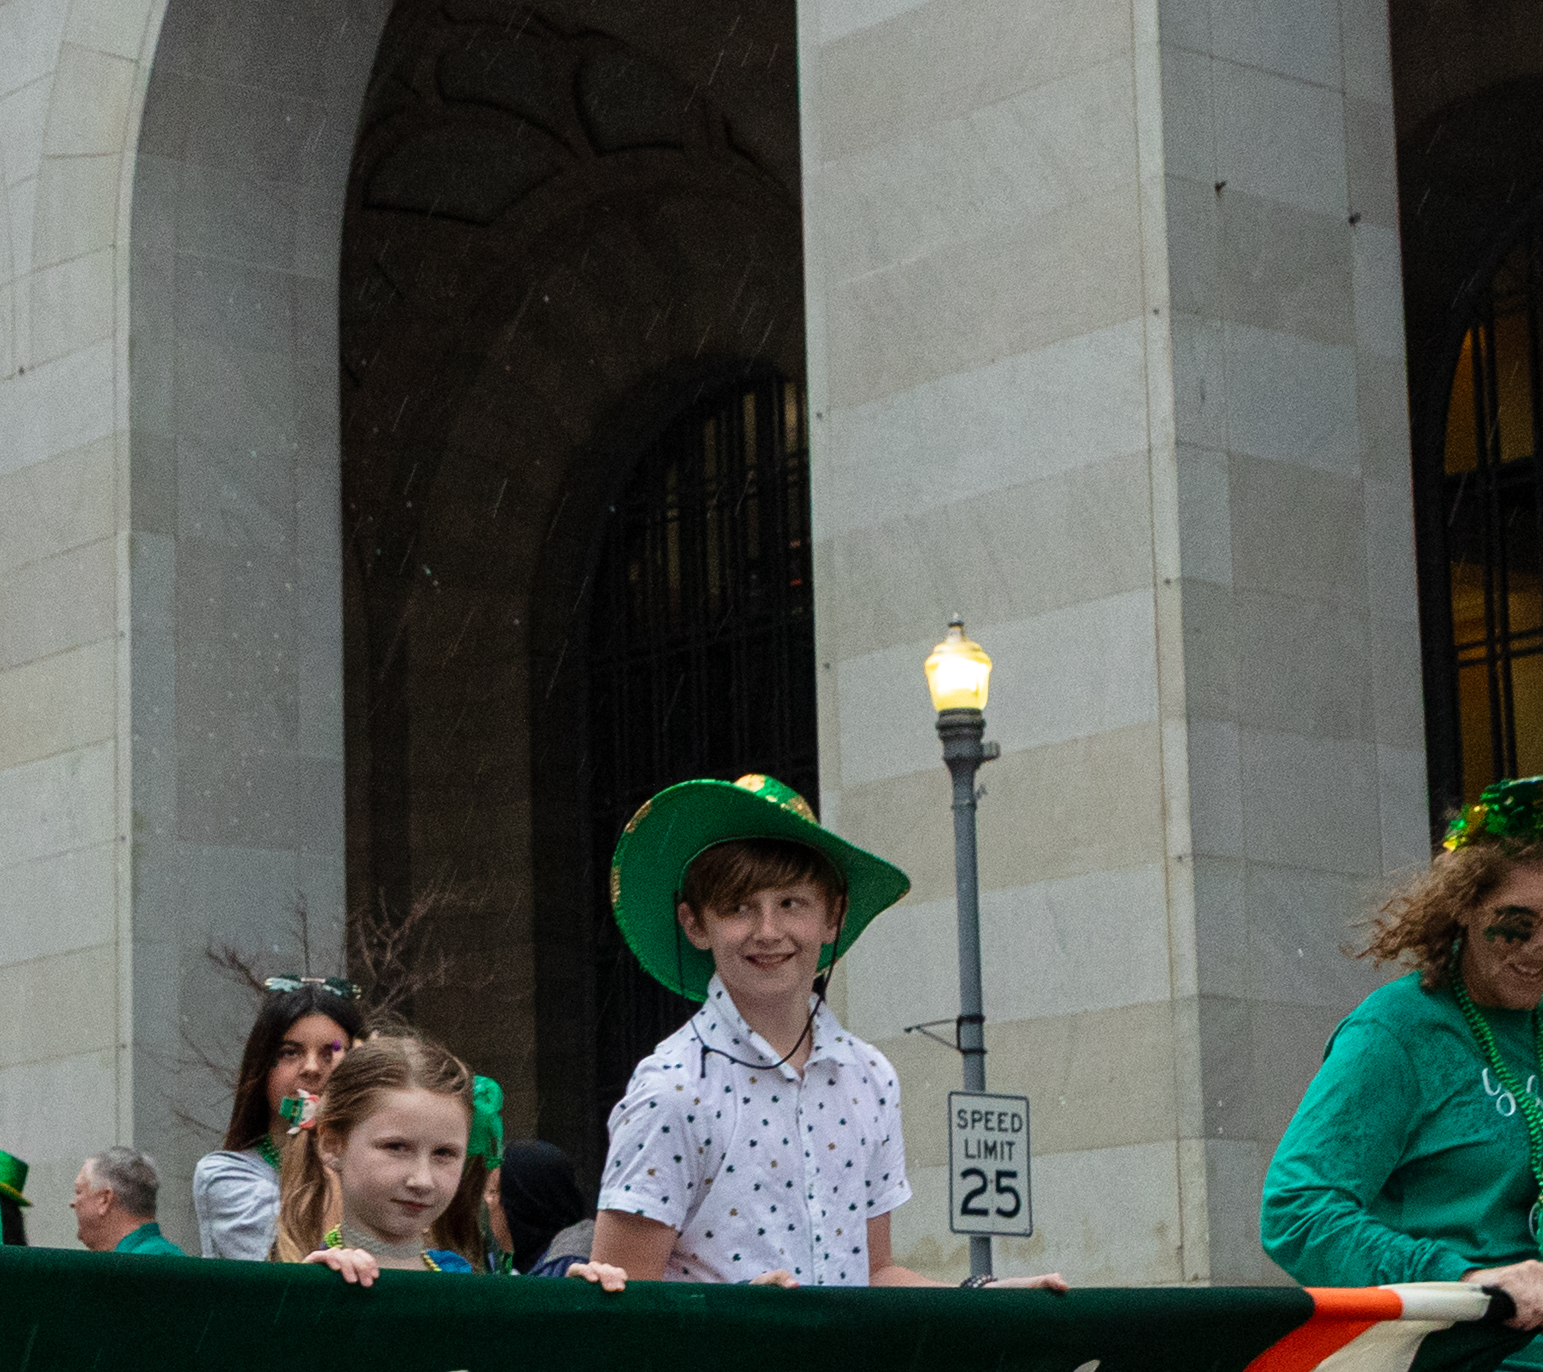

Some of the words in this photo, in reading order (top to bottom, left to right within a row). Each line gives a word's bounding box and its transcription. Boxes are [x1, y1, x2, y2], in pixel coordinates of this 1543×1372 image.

[956, 1108, 1023, 1134] SPEED
[964, 1138, 1017, 1162] LIMIT
[960, 1168, 1021, 1218] 25
